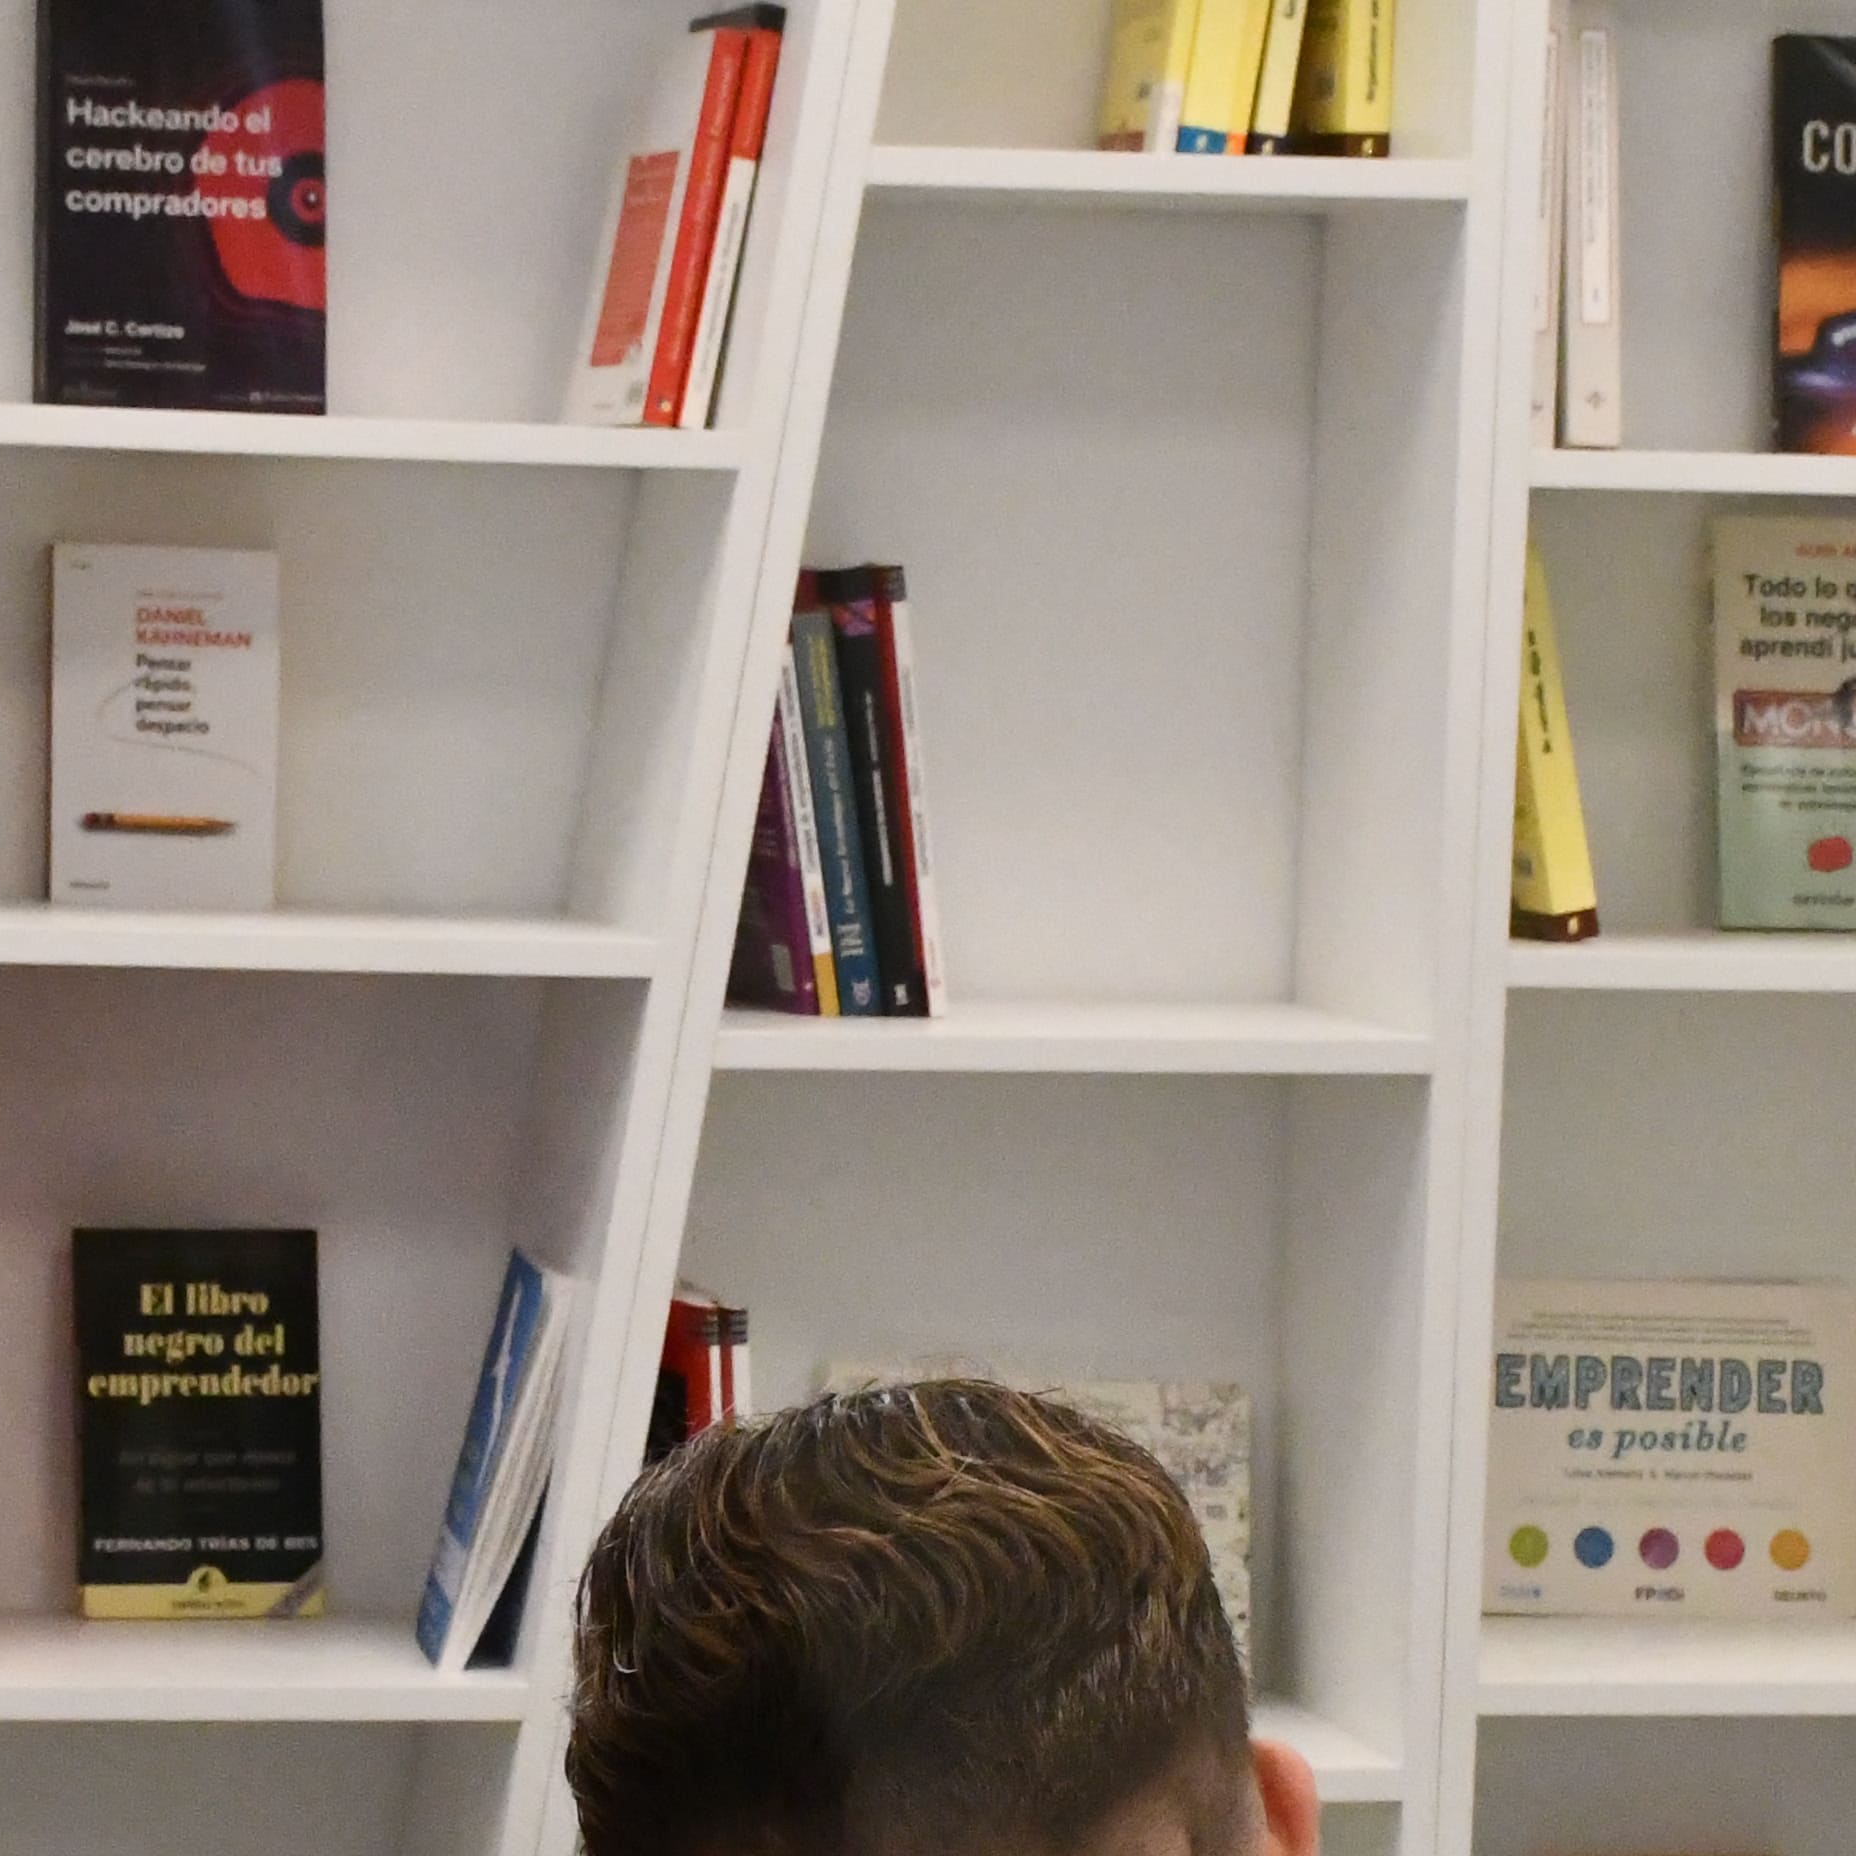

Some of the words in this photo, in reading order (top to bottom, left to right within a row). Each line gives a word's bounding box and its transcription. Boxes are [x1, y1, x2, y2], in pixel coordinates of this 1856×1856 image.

[65, 97, 240, 132] Hackeando
[245, 105, 272, 133] el
[65, 145, 185, 174] cerebro
[190, 147, 226, 175] de
[235, 152, 283, 177] tus
[65, 187, 268, 220] compradores
[1744, 573, 1807, 598] Todo
[1815, 575, 1838, 599] lo
[1760, 605, 1797, 627] los
[139, 1282, 175, 1317] El
[185, 1281, 270, 1317] libro
[123, 1329, 225, 1364] negro
[233, 1323, 286, 1357] del
[87, 1363, 320, 1406] emprendedor
[1494, 1352, 1825, 1415] EMPRENDER
[1567, 1426, 1603, 1450] es
[1611, 1420, 1748, 1460] posible
